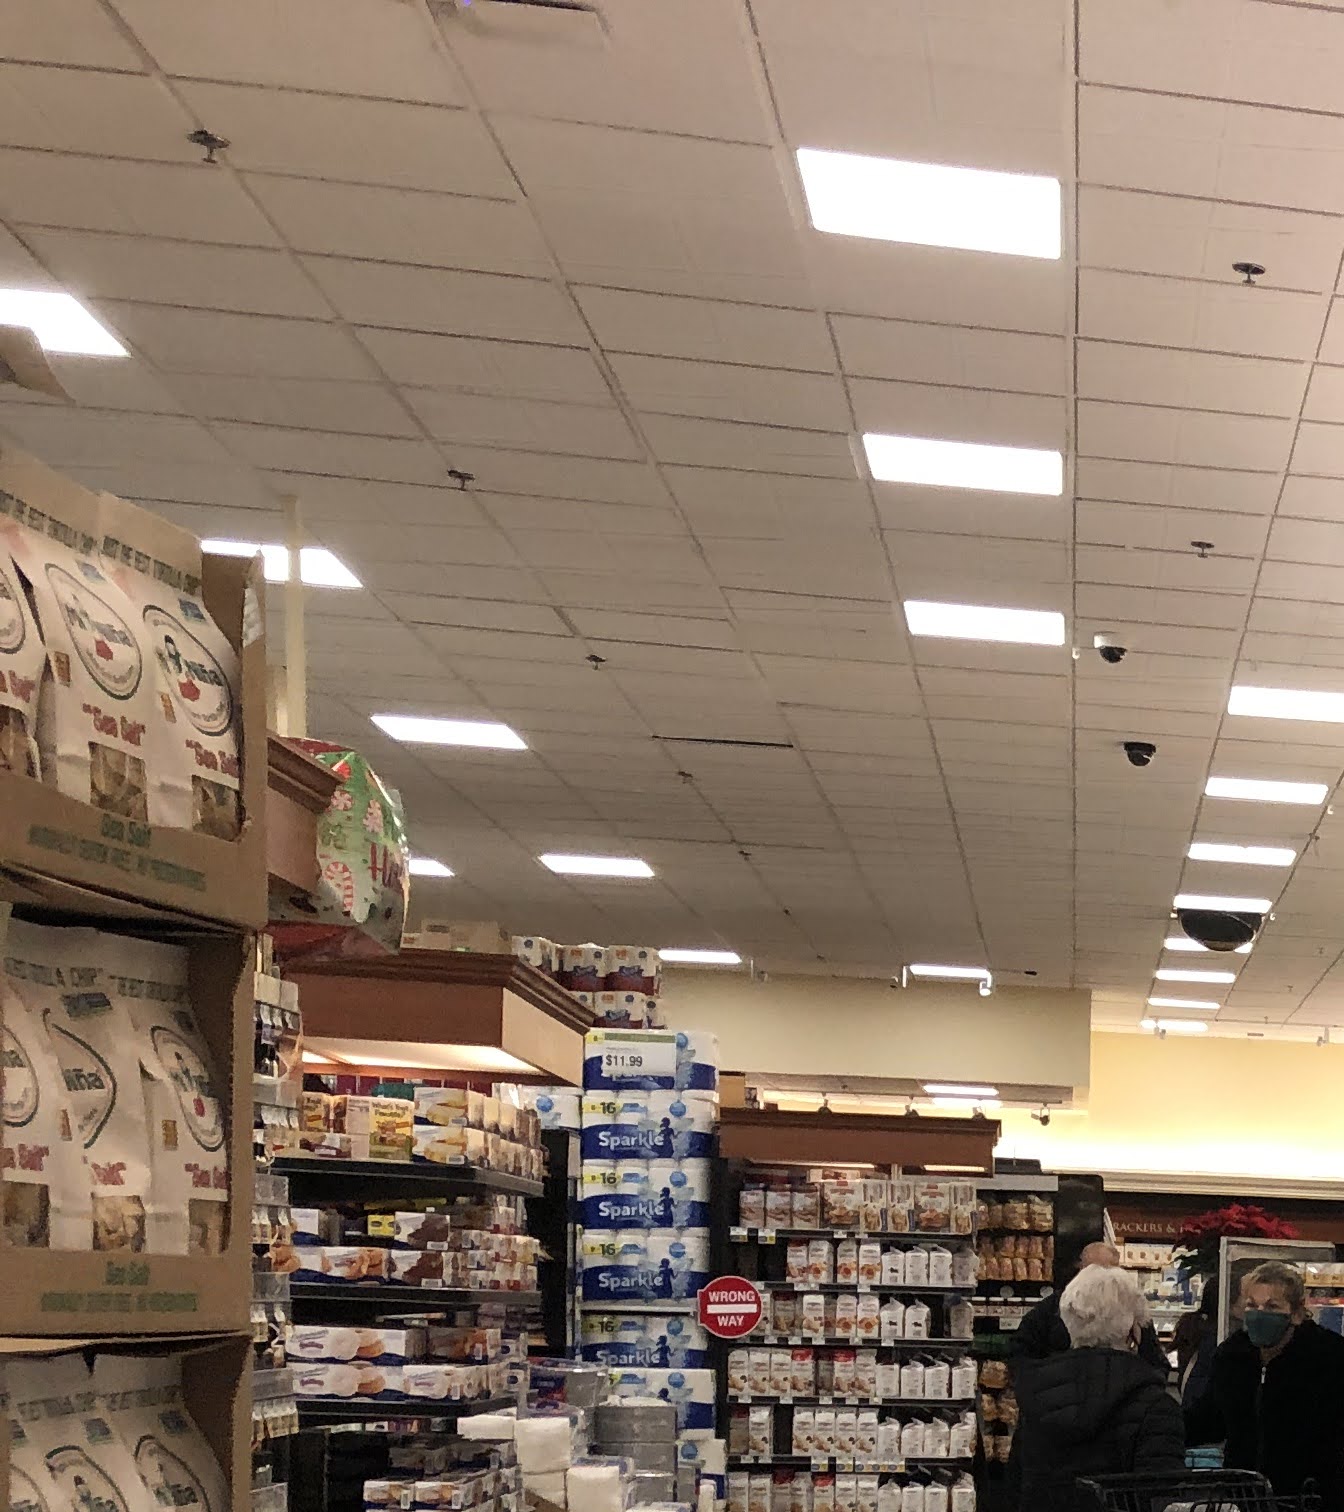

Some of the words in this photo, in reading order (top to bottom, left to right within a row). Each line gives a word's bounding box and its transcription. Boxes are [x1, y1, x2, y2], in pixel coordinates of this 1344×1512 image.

[605, 1054, 643, 1067] $11.99
[600, 1102, 616, 1115] 16
[598, 1130, 664, 1150] Sparkle
[600, 1172, 617, 1185] 16
[598, 1201, 665, 1220] Sparkle
[1112, 1222, 1162, 1233] RACKERS
[599, 1243, 616, 1256] 16
[598, 1273, 663, 1290] Sparkle
[708, 1290, 755, 1302] WRONG
[717, 1315, 745, 1327] WAY
[597, 1350, 660, 1366] Sparkle
